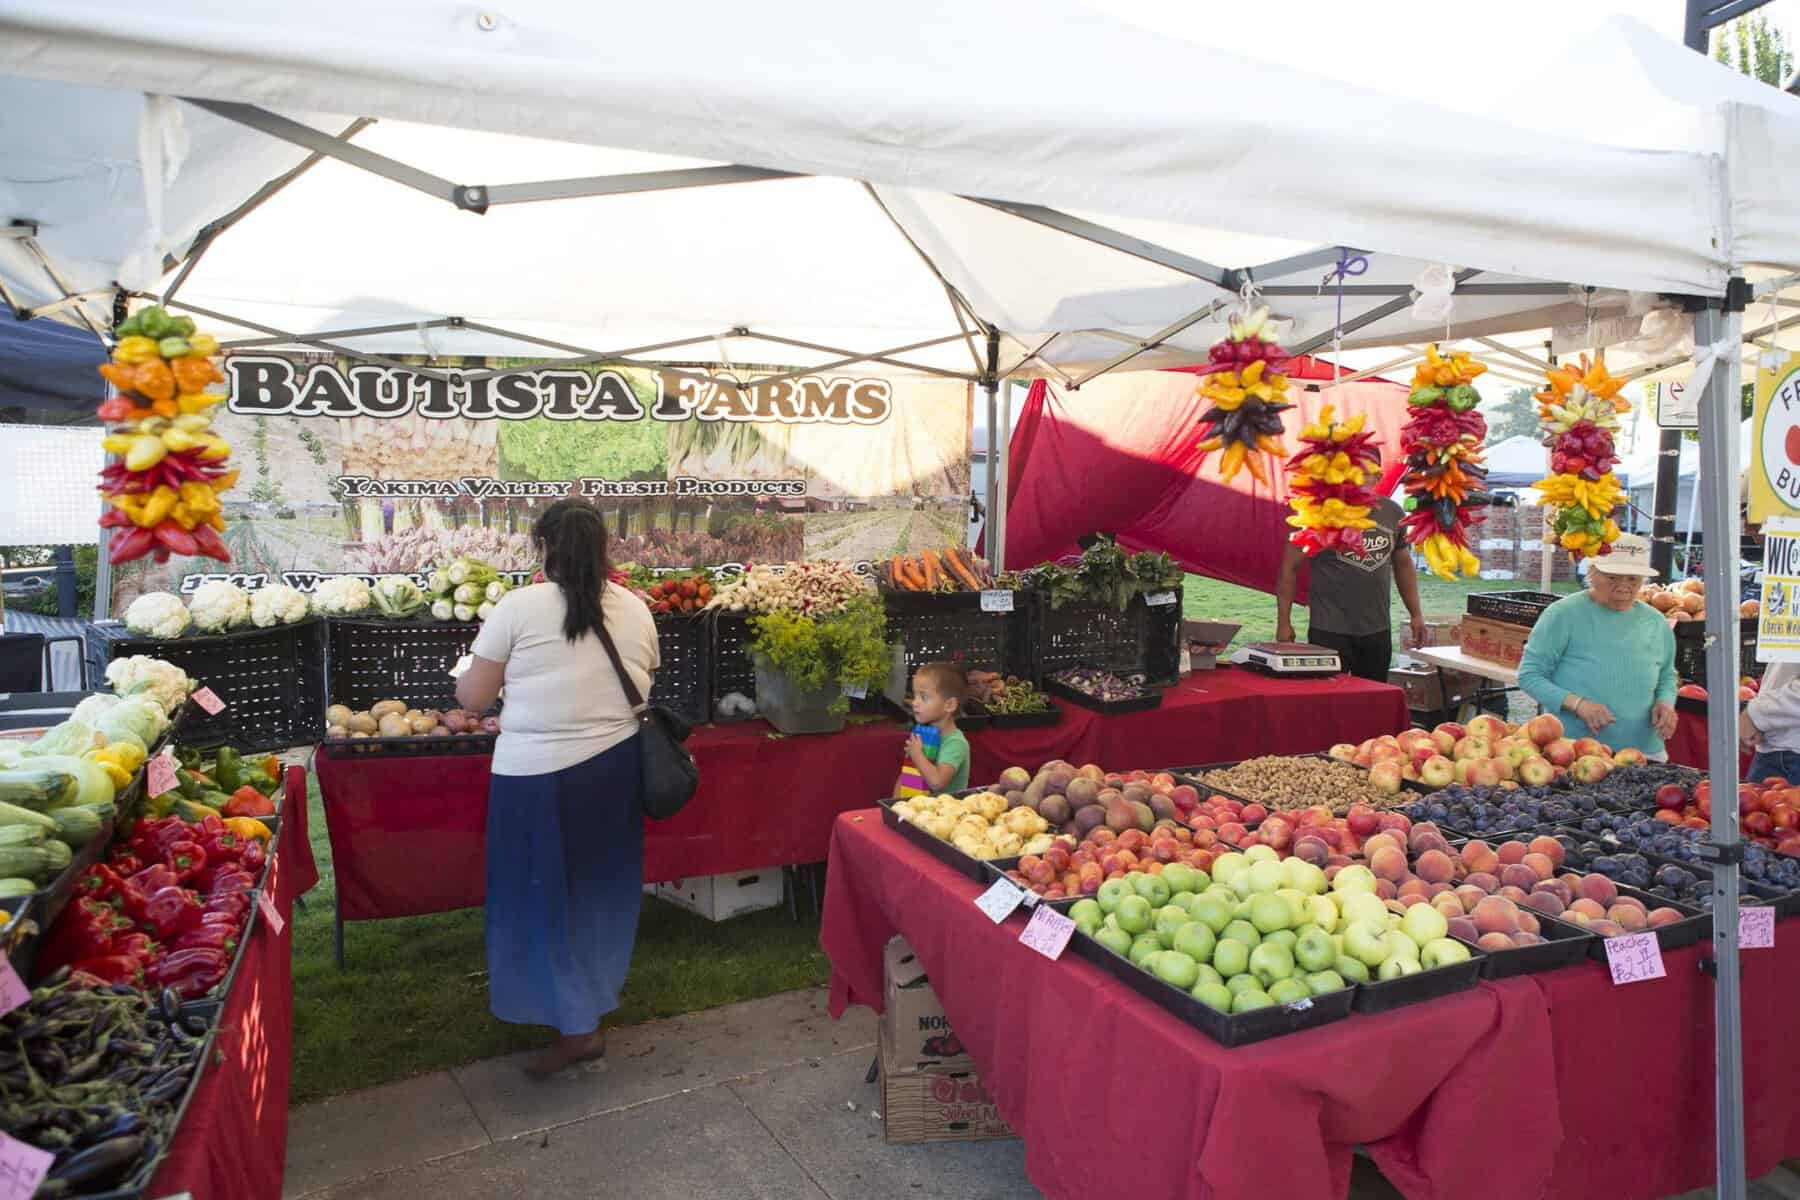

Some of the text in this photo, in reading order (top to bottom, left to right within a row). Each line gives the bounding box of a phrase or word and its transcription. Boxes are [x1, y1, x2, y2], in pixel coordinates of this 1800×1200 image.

[226, 356, 891, 423] BAUTISTA FARMS
[340, 476, 806, 498] YAKIMA VALLEY FRESH PRODUCTS
[1606, 936, 1650, 954] Peaches
